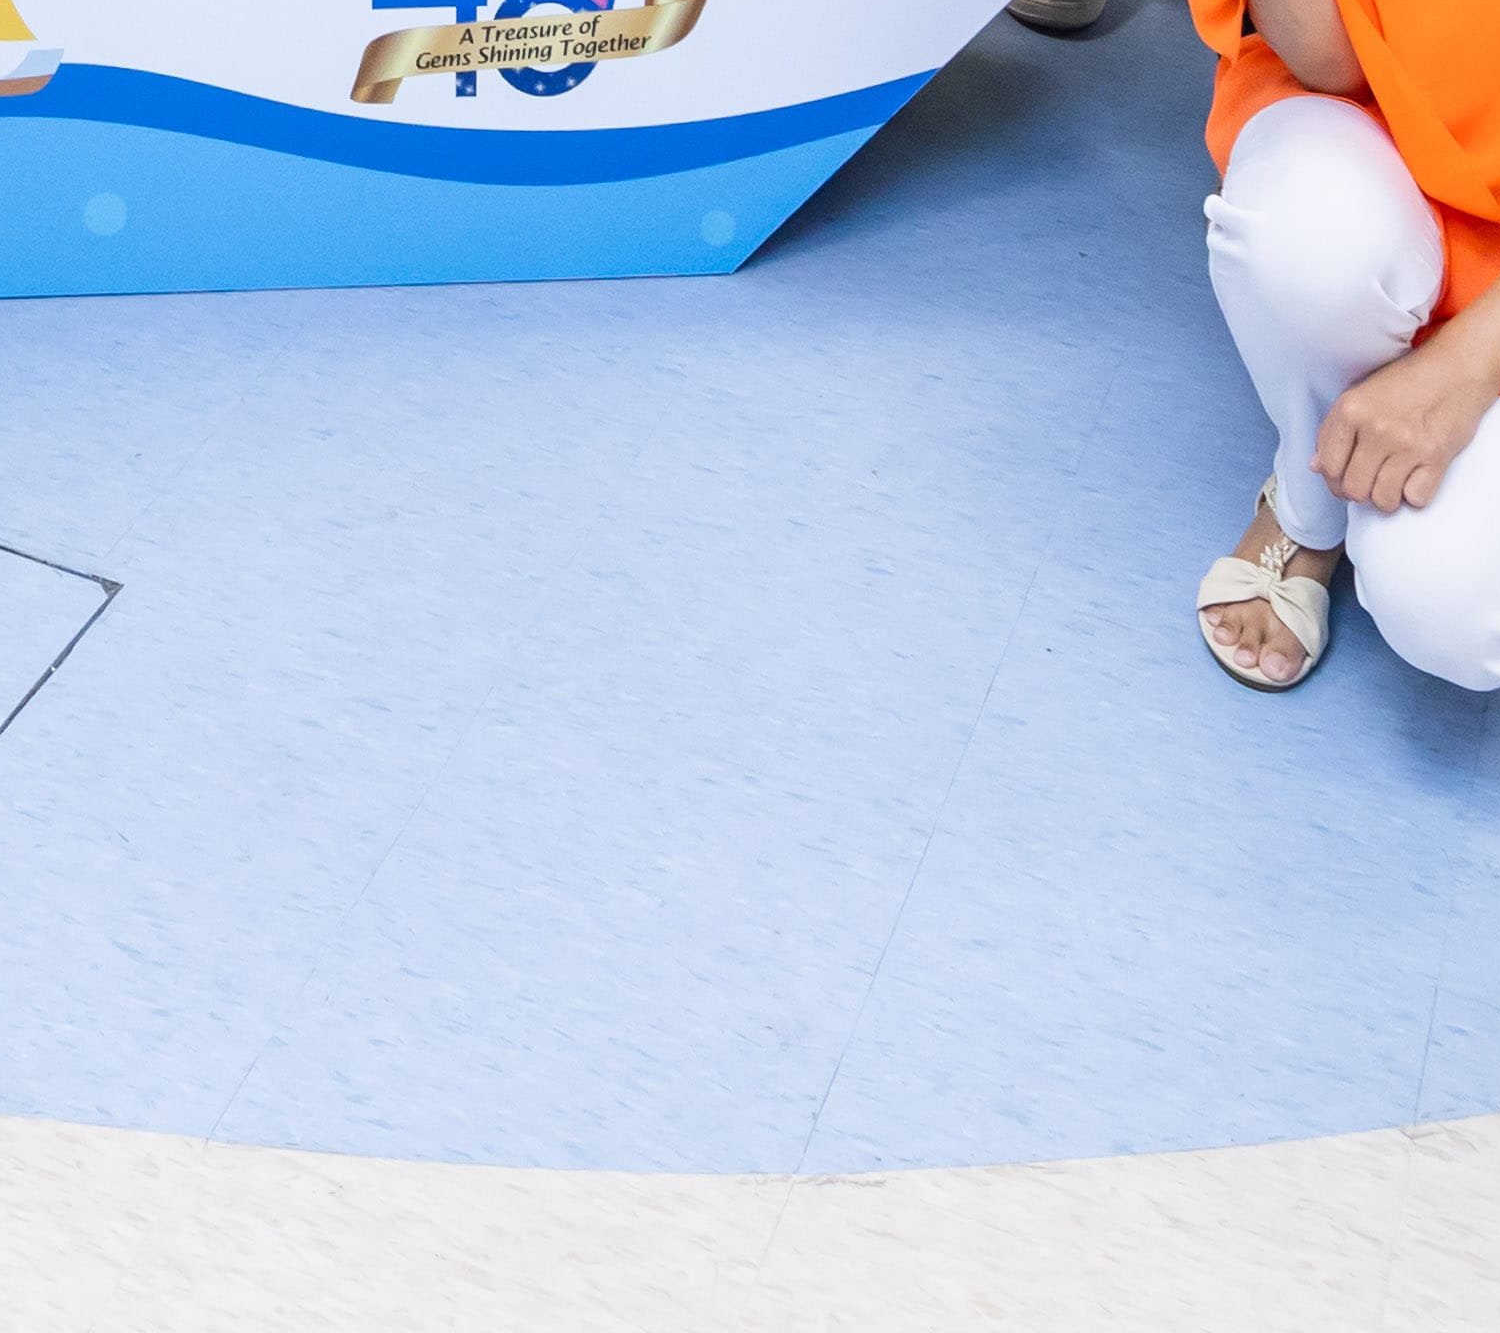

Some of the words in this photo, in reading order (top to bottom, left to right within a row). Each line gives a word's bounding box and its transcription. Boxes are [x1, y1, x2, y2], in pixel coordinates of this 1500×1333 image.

[459, 27, 474, 46] A
[481, 21, 574, 44] Treasure
[579, 14, 601, 37] of
[416, 46, 472, 71] Gems
[478, 42, 553, 68] Shining
[560, 34, 651, 61] Together
